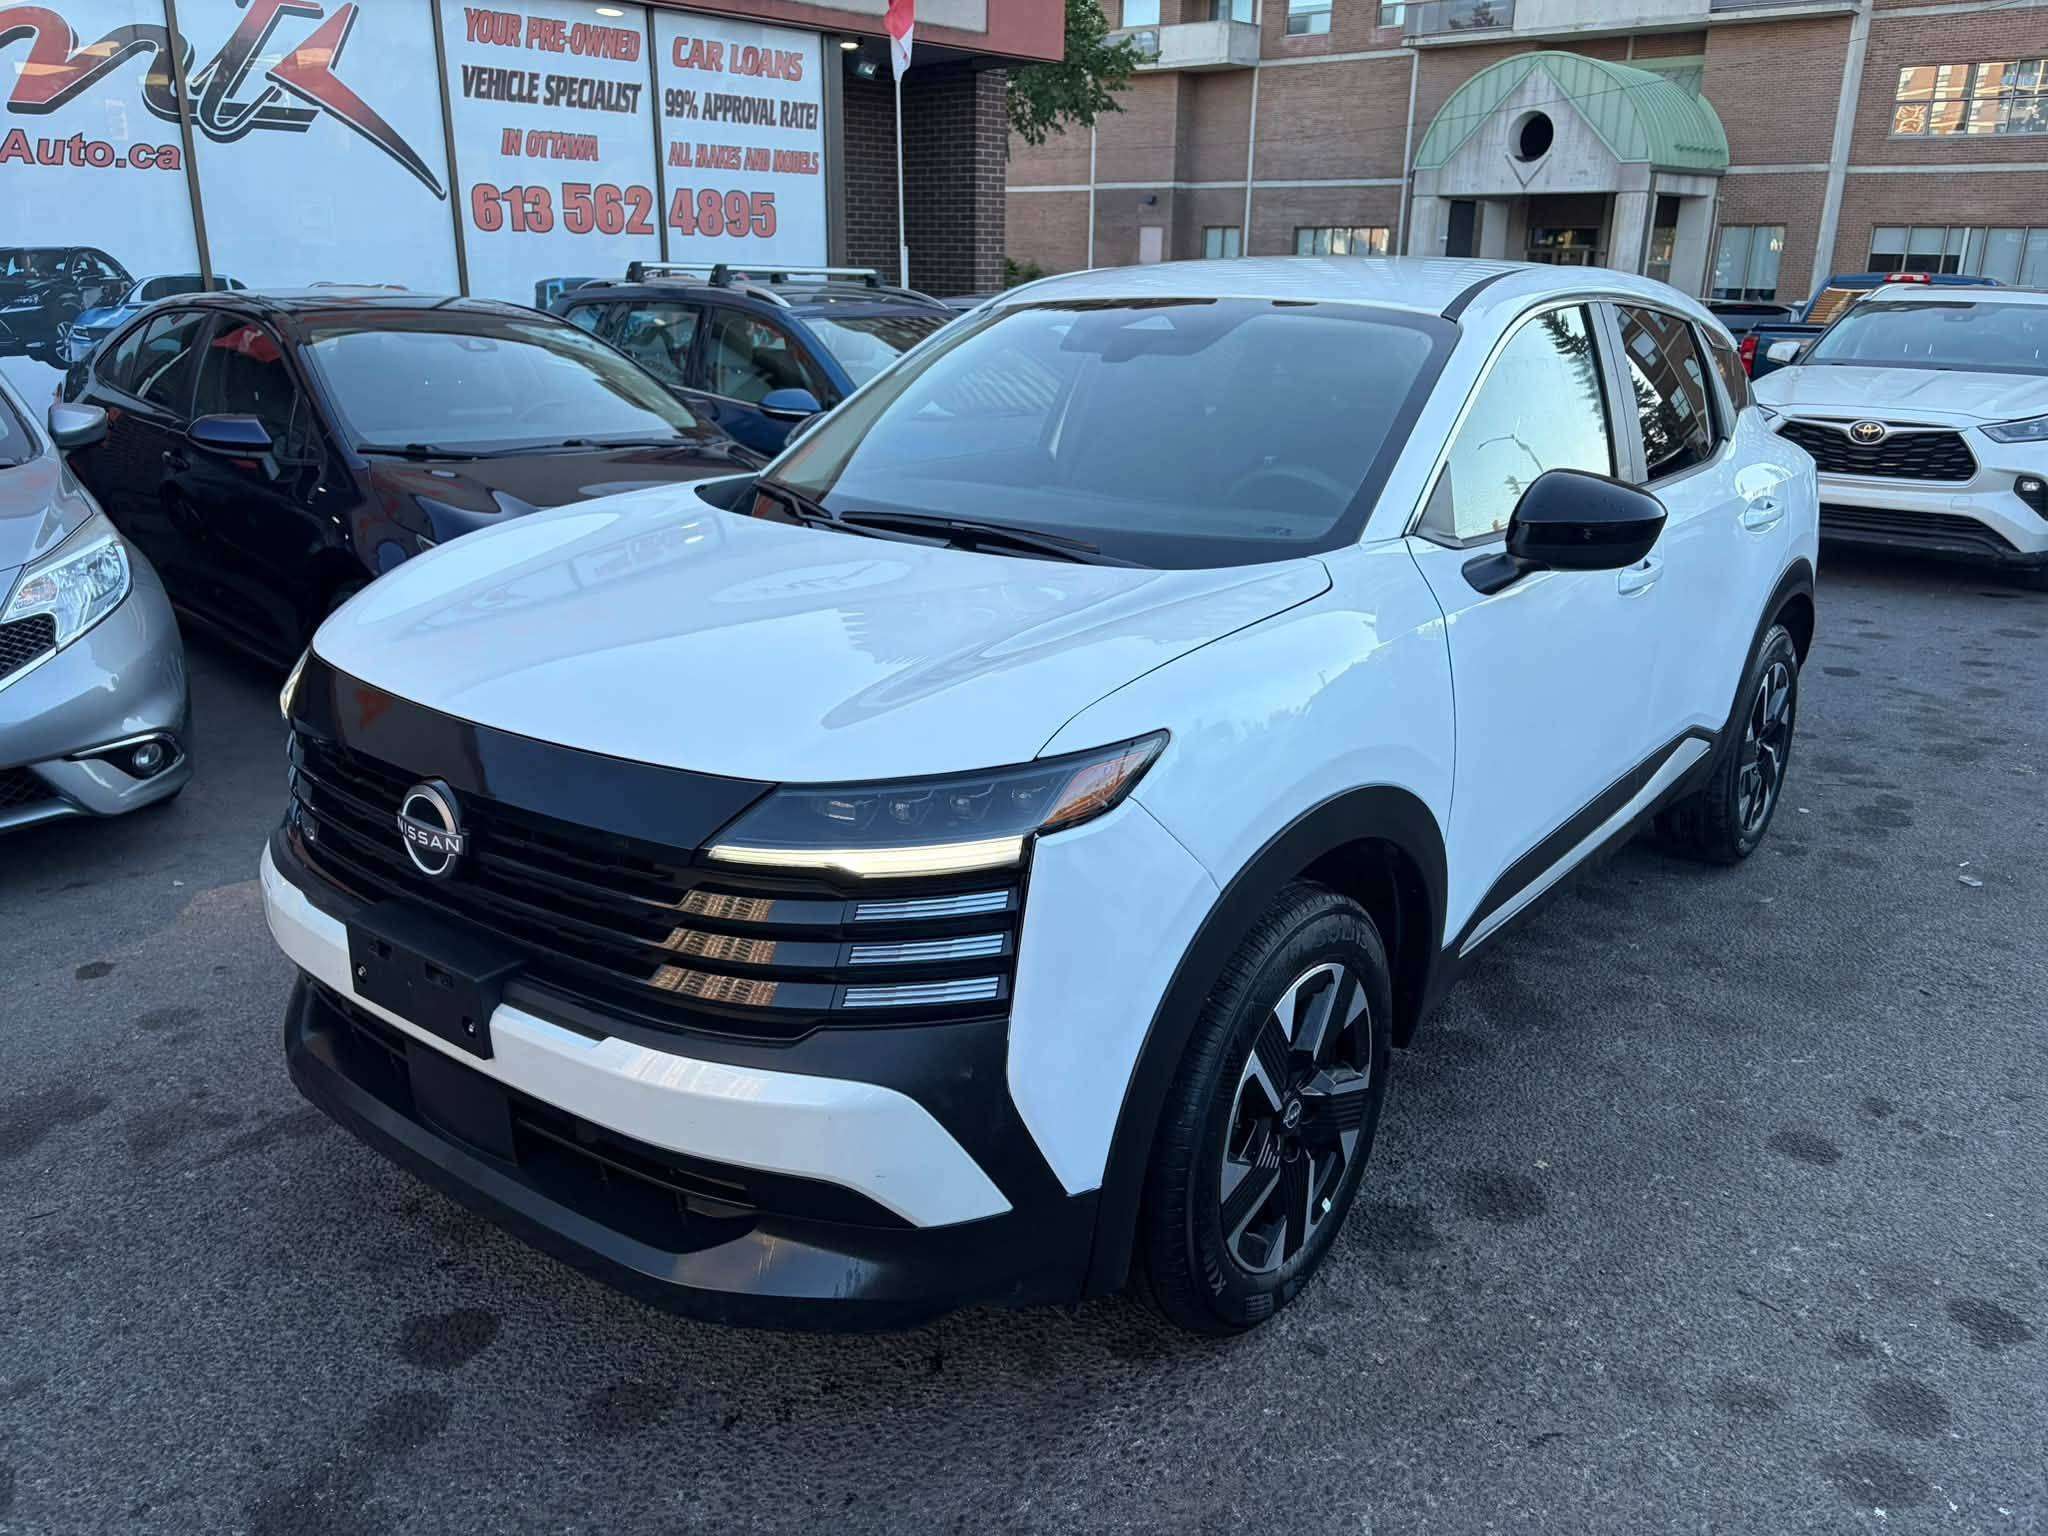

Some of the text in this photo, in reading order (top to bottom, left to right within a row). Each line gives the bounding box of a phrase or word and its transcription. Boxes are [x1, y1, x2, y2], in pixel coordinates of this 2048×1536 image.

[464, 8, 641, 62] YOUR PRE-OWNED
[672, 36, 804, 82] CAR LOANS
[461, 64, 642, 114] VEHICLE SPECIALIST
[665, 88, 819, 130] 99% APPROVAL RATE!
[0, 129, 181, 170] Auto.ca
[501, 128, 599, 162] IN OTTAWA
[668, 141, 819, 176] ALL MAKES AND MODELS
[471, 183, 777, 238] 613 562 4895
[397, 815, 460, 852] NISSAN
